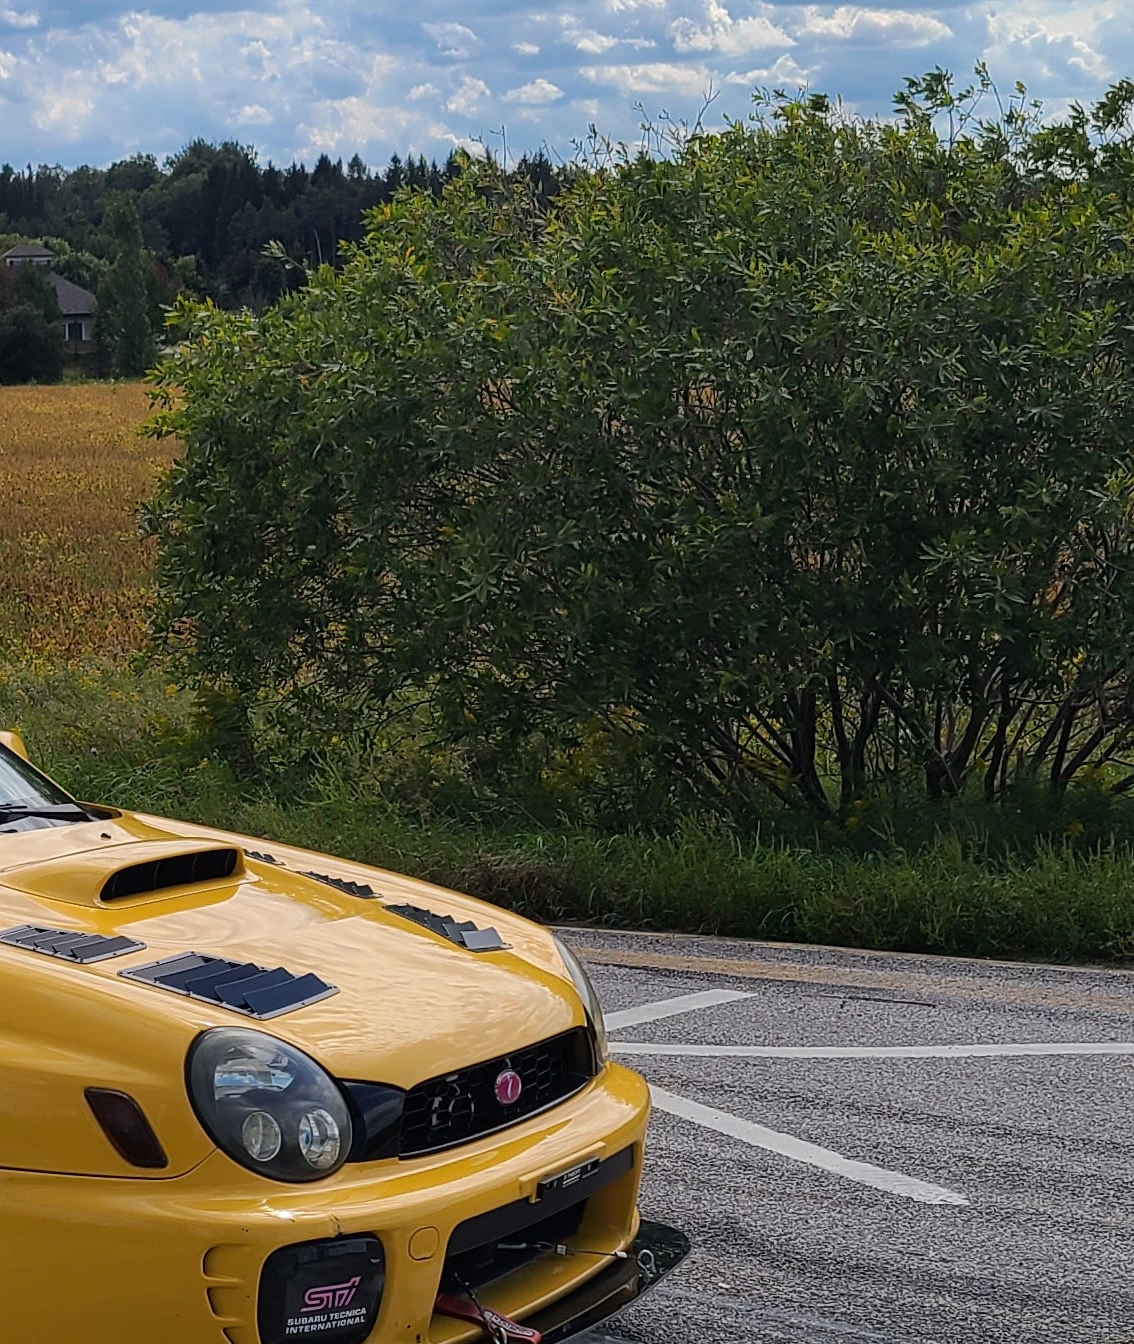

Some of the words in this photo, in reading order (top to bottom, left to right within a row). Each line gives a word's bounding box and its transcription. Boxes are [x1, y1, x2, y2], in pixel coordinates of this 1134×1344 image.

[285, 1316, 366, 1335] INTERNATIONAL
[287, 1314, 327, 1327] SUBARU
[329, 1307, 367, 1321] TECNICA
